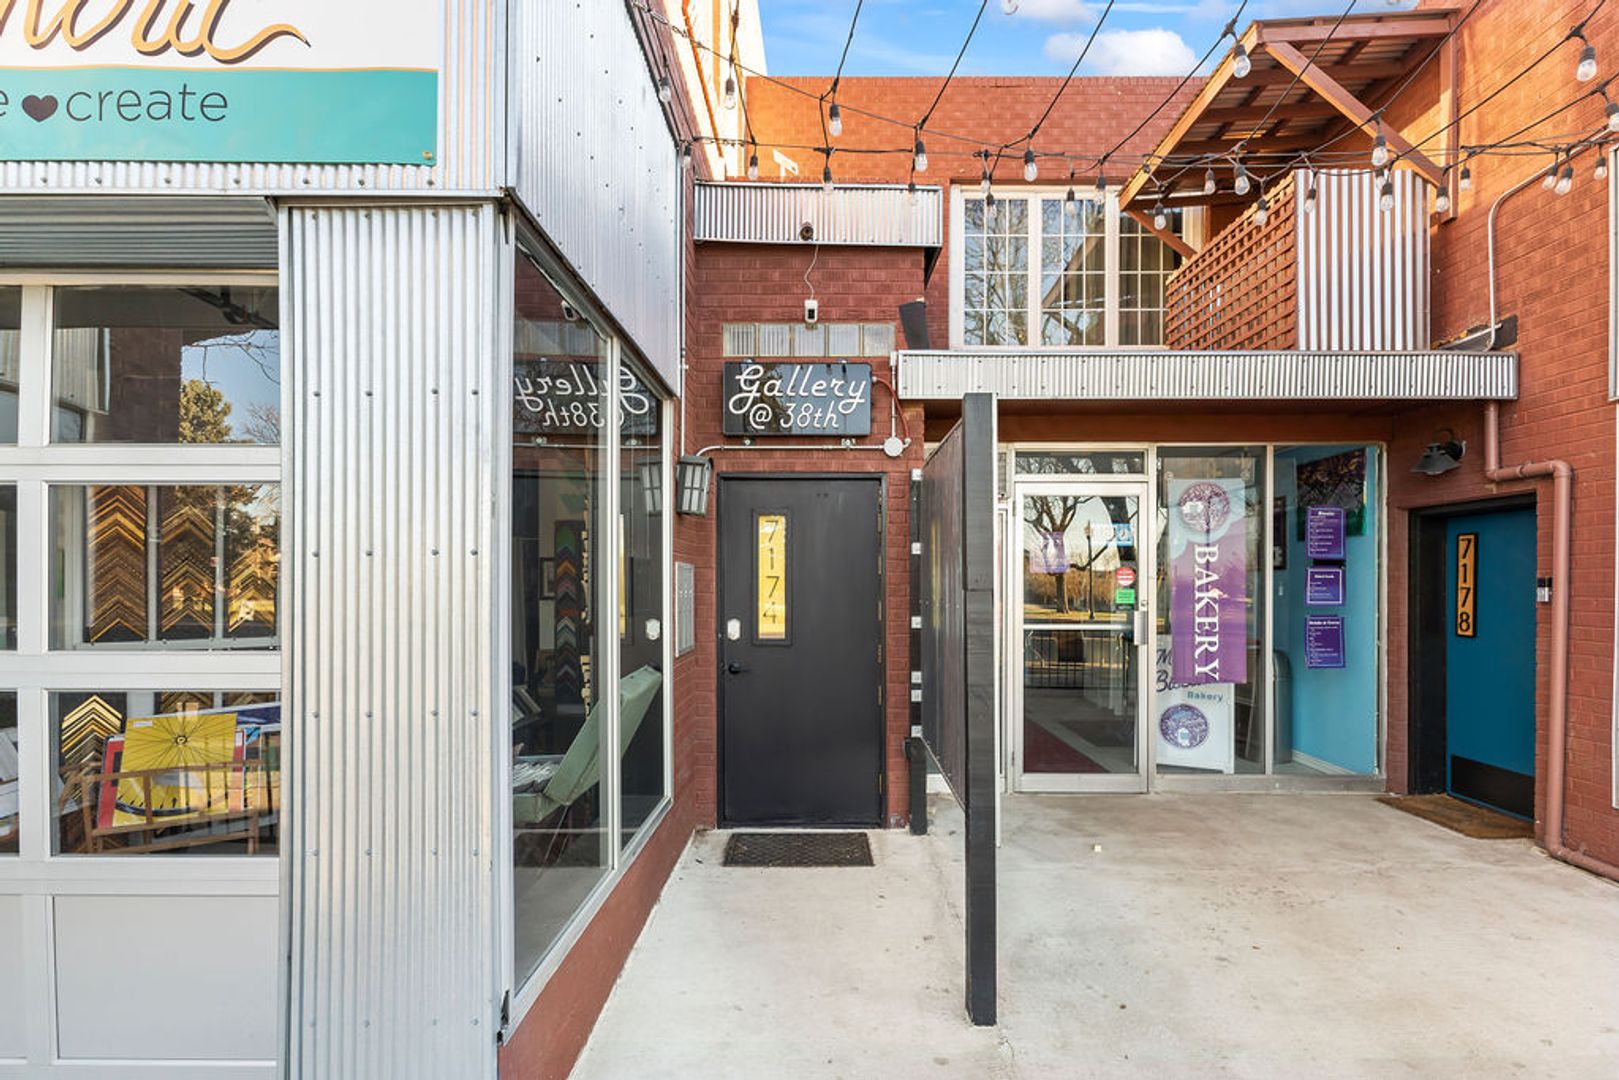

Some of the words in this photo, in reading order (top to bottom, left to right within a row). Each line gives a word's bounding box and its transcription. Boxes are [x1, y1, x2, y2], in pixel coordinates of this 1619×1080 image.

[66, 83, 228, 122] create
[728, 364, 867, 415] Gallery
[749, 403, 772, 429] @
[779, 400, 840, 429] 38th
[762, 519, 780, 624] 7174
[1458, 537, 1473, 633] 7178
[1194, 544, 1220, 681] BAKERY
[1187, 691, 1224, 702] Bakery
